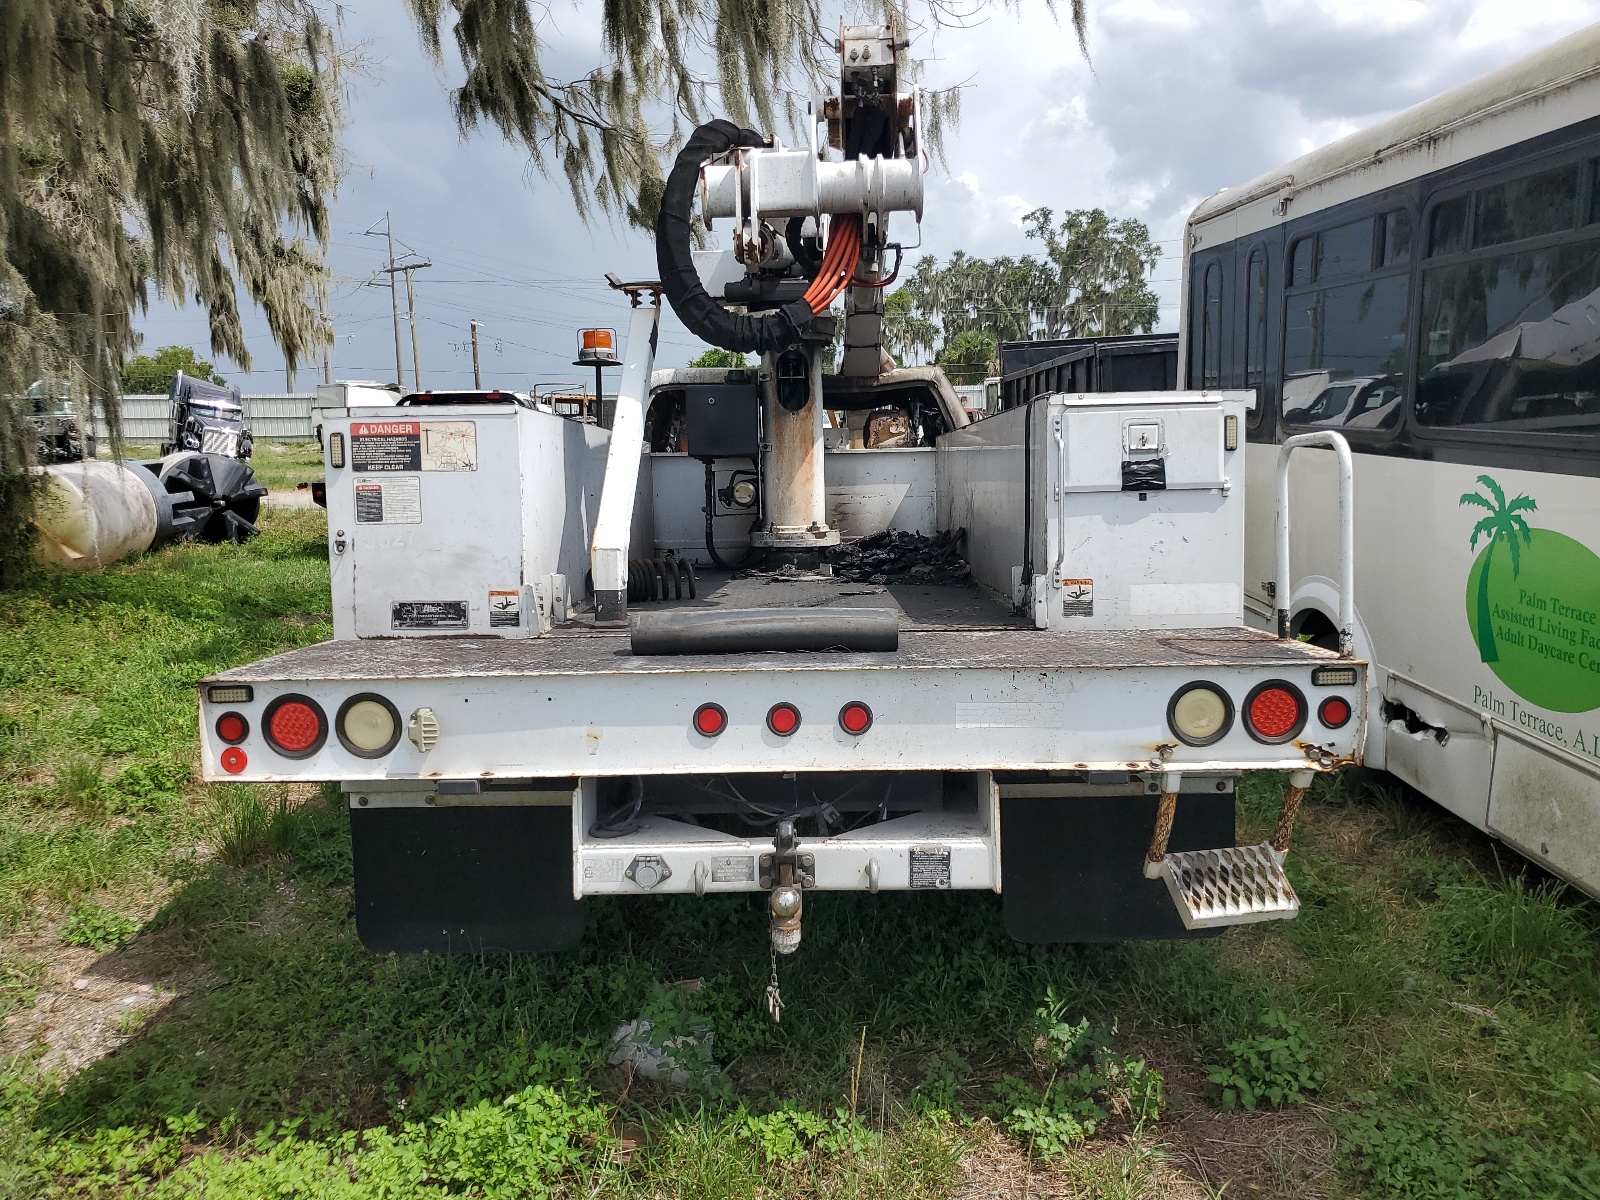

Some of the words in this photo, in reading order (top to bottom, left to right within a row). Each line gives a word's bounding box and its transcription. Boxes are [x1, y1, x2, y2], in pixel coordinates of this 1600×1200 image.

[370, 424, 413, 434] DANGER
[423, 604, 444, 613] Altec
[1492, 603, 1535, 629] Assisted
[1538, 616, 1577, 646] Living
[1519, 589, 1547, 611] Palm
[1551, 597, 1596, 625] Terrace
[1495, 624, 1524, 647] Adult
[1528, 634, 1575, 664] Daycare
[1473, 685, 1505, 715] Palm
[1509, 700, 1567, 748] Terrace,
